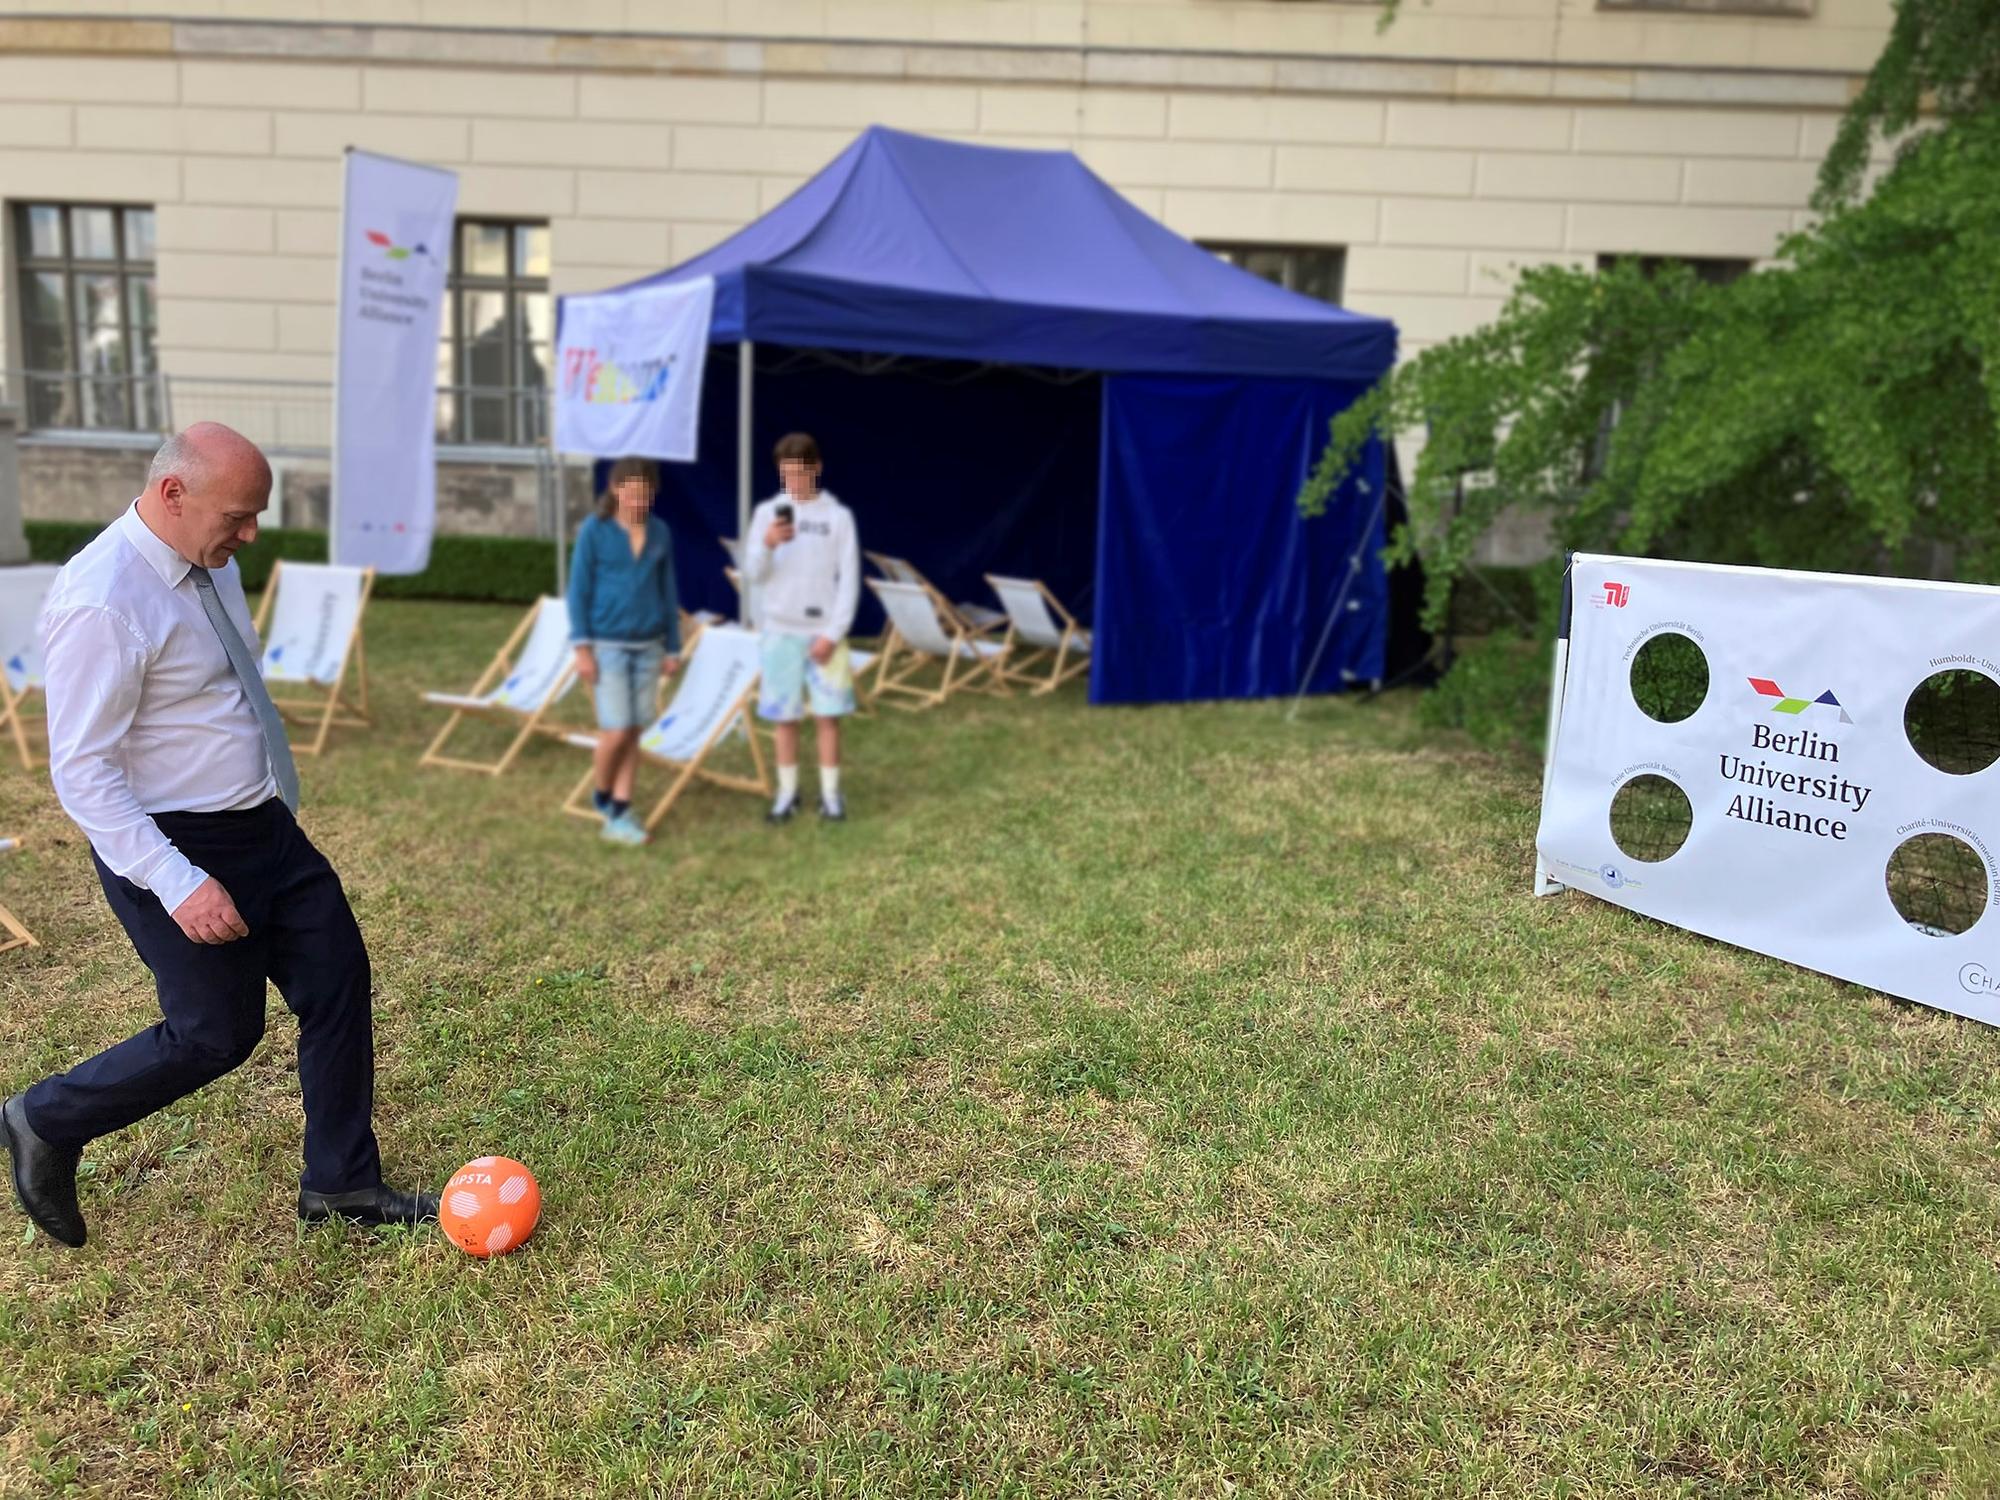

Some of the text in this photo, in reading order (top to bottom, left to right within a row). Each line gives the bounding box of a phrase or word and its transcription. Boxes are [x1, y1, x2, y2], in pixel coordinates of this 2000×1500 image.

[1622, 620, 1705, 662] Technische Universität Berlin
[1752, 723, 1839, 763] Berlin
[1661, 764, 1681, 780] Berlin
[1719, 754, 1872, 813] University
[1725, 794, 1847, 840] Alliance
